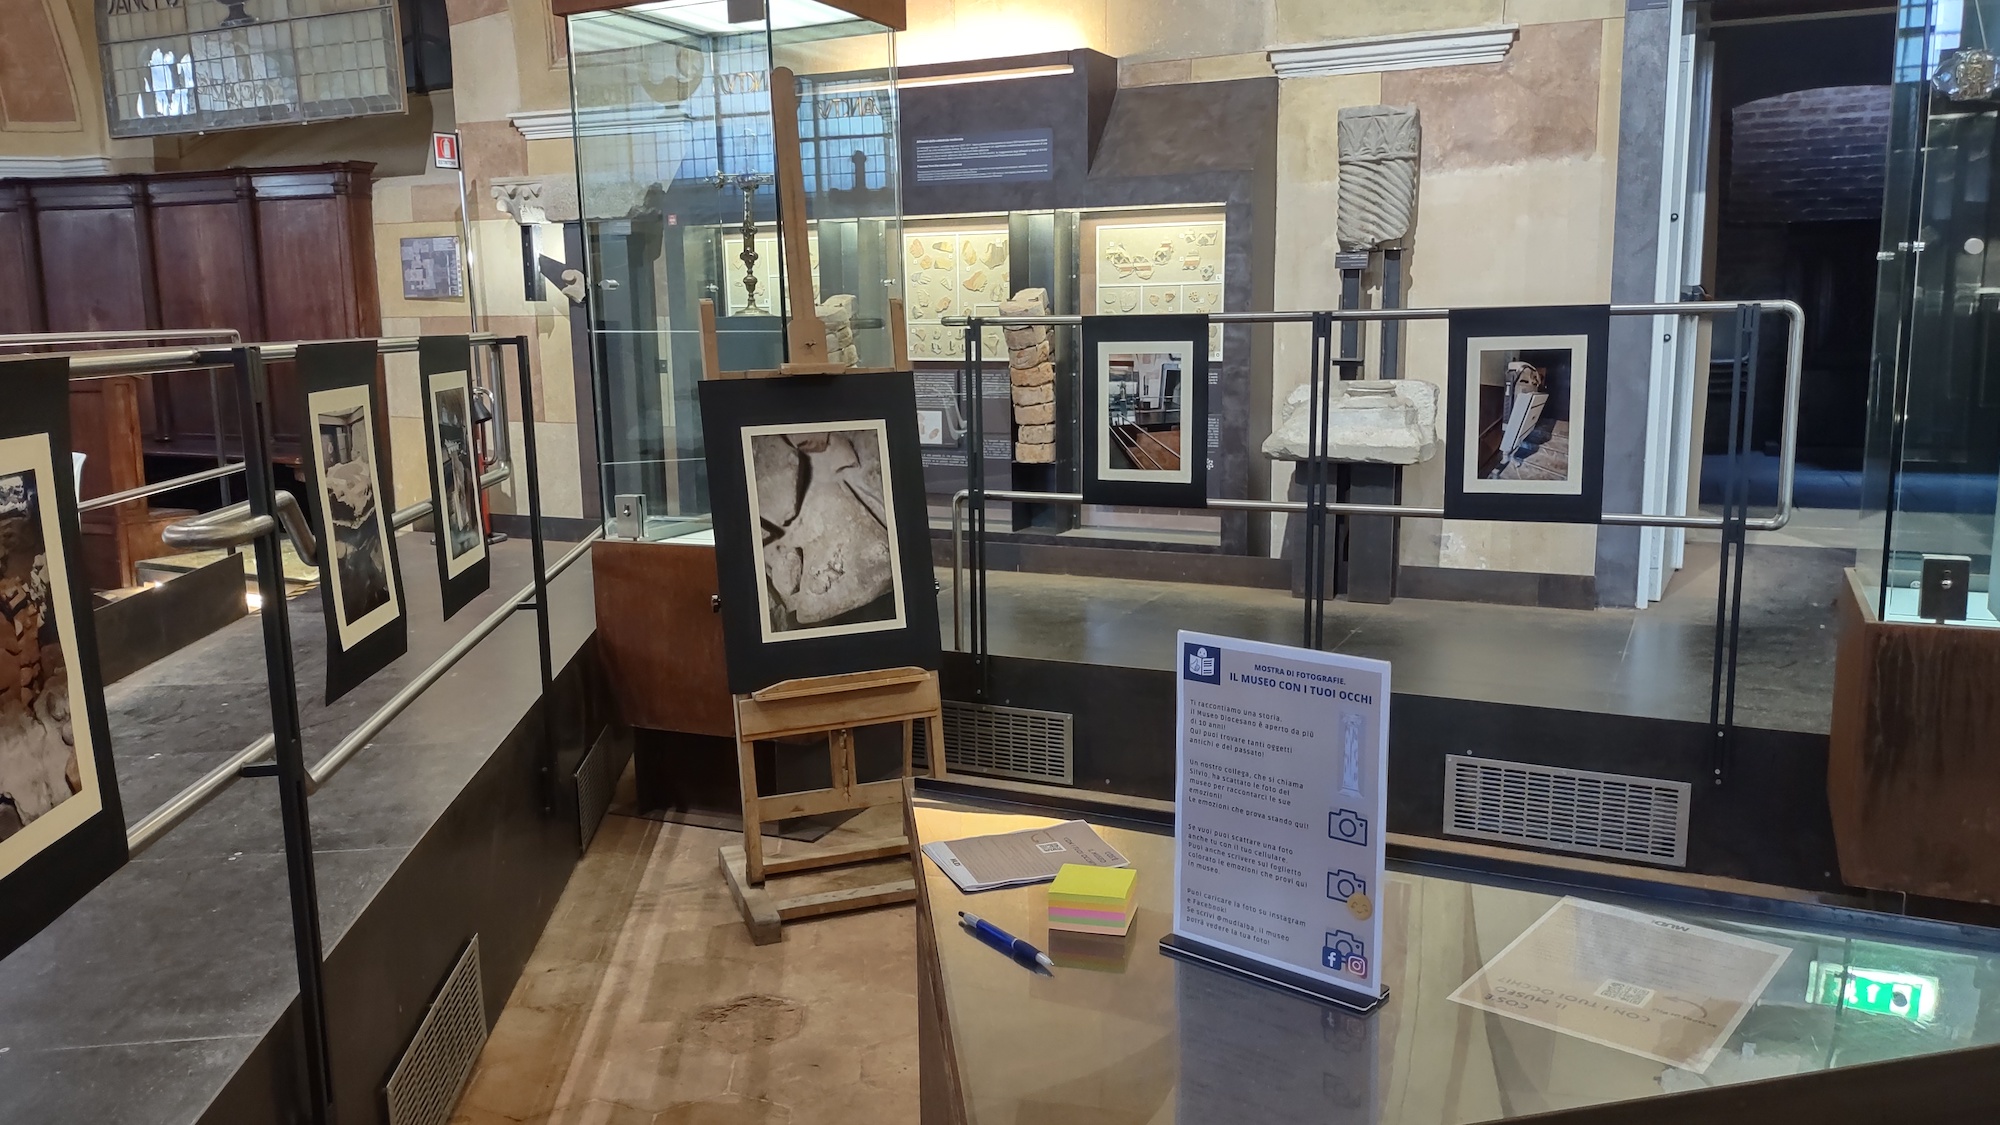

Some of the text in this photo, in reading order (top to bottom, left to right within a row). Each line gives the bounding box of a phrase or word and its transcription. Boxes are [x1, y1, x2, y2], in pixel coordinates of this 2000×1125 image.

[1254, 663, 1284, 675] MOSTRA
[1296, 670, 1346, 685] FOTOGRAFIE.
[1229, 672, 1372, 705] IL MUSEO CON I TUOI OCCHI
[1496, 986, 1550, 1005] MUSEO
[1560, 993, 1598, 1009] TUOI
[1613, 1008, 1650, 1022] CON
